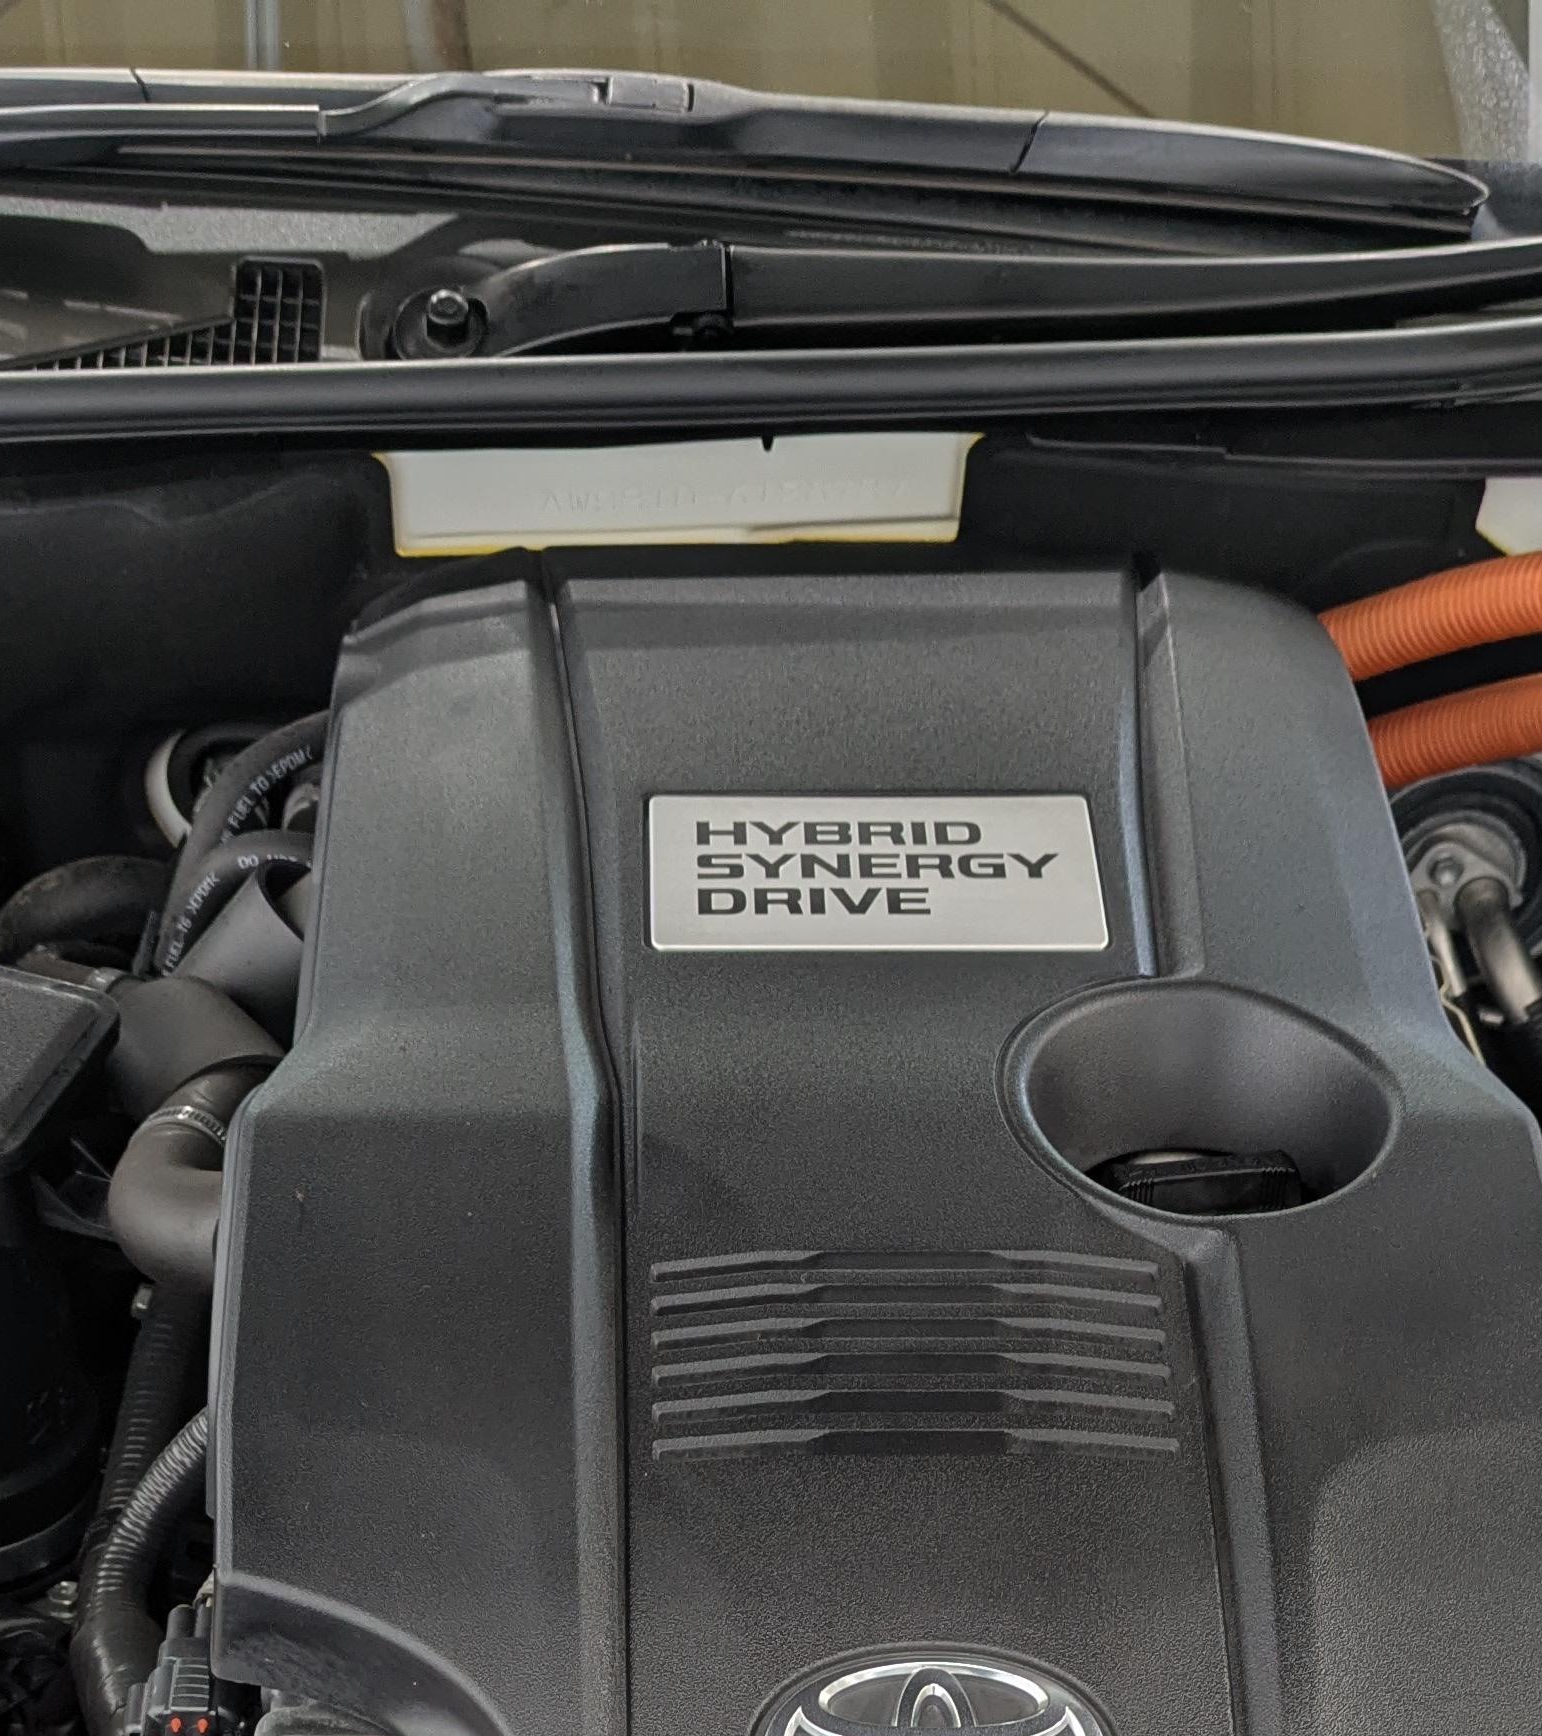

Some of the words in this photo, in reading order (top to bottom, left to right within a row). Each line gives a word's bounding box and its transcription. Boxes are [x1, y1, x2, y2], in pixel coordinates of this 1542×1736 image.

[695, 821, 982, 846] HYBRID
[696, 852, 1059, 880] SYNERGY
[697, 887, 932, 915] DRIVE
